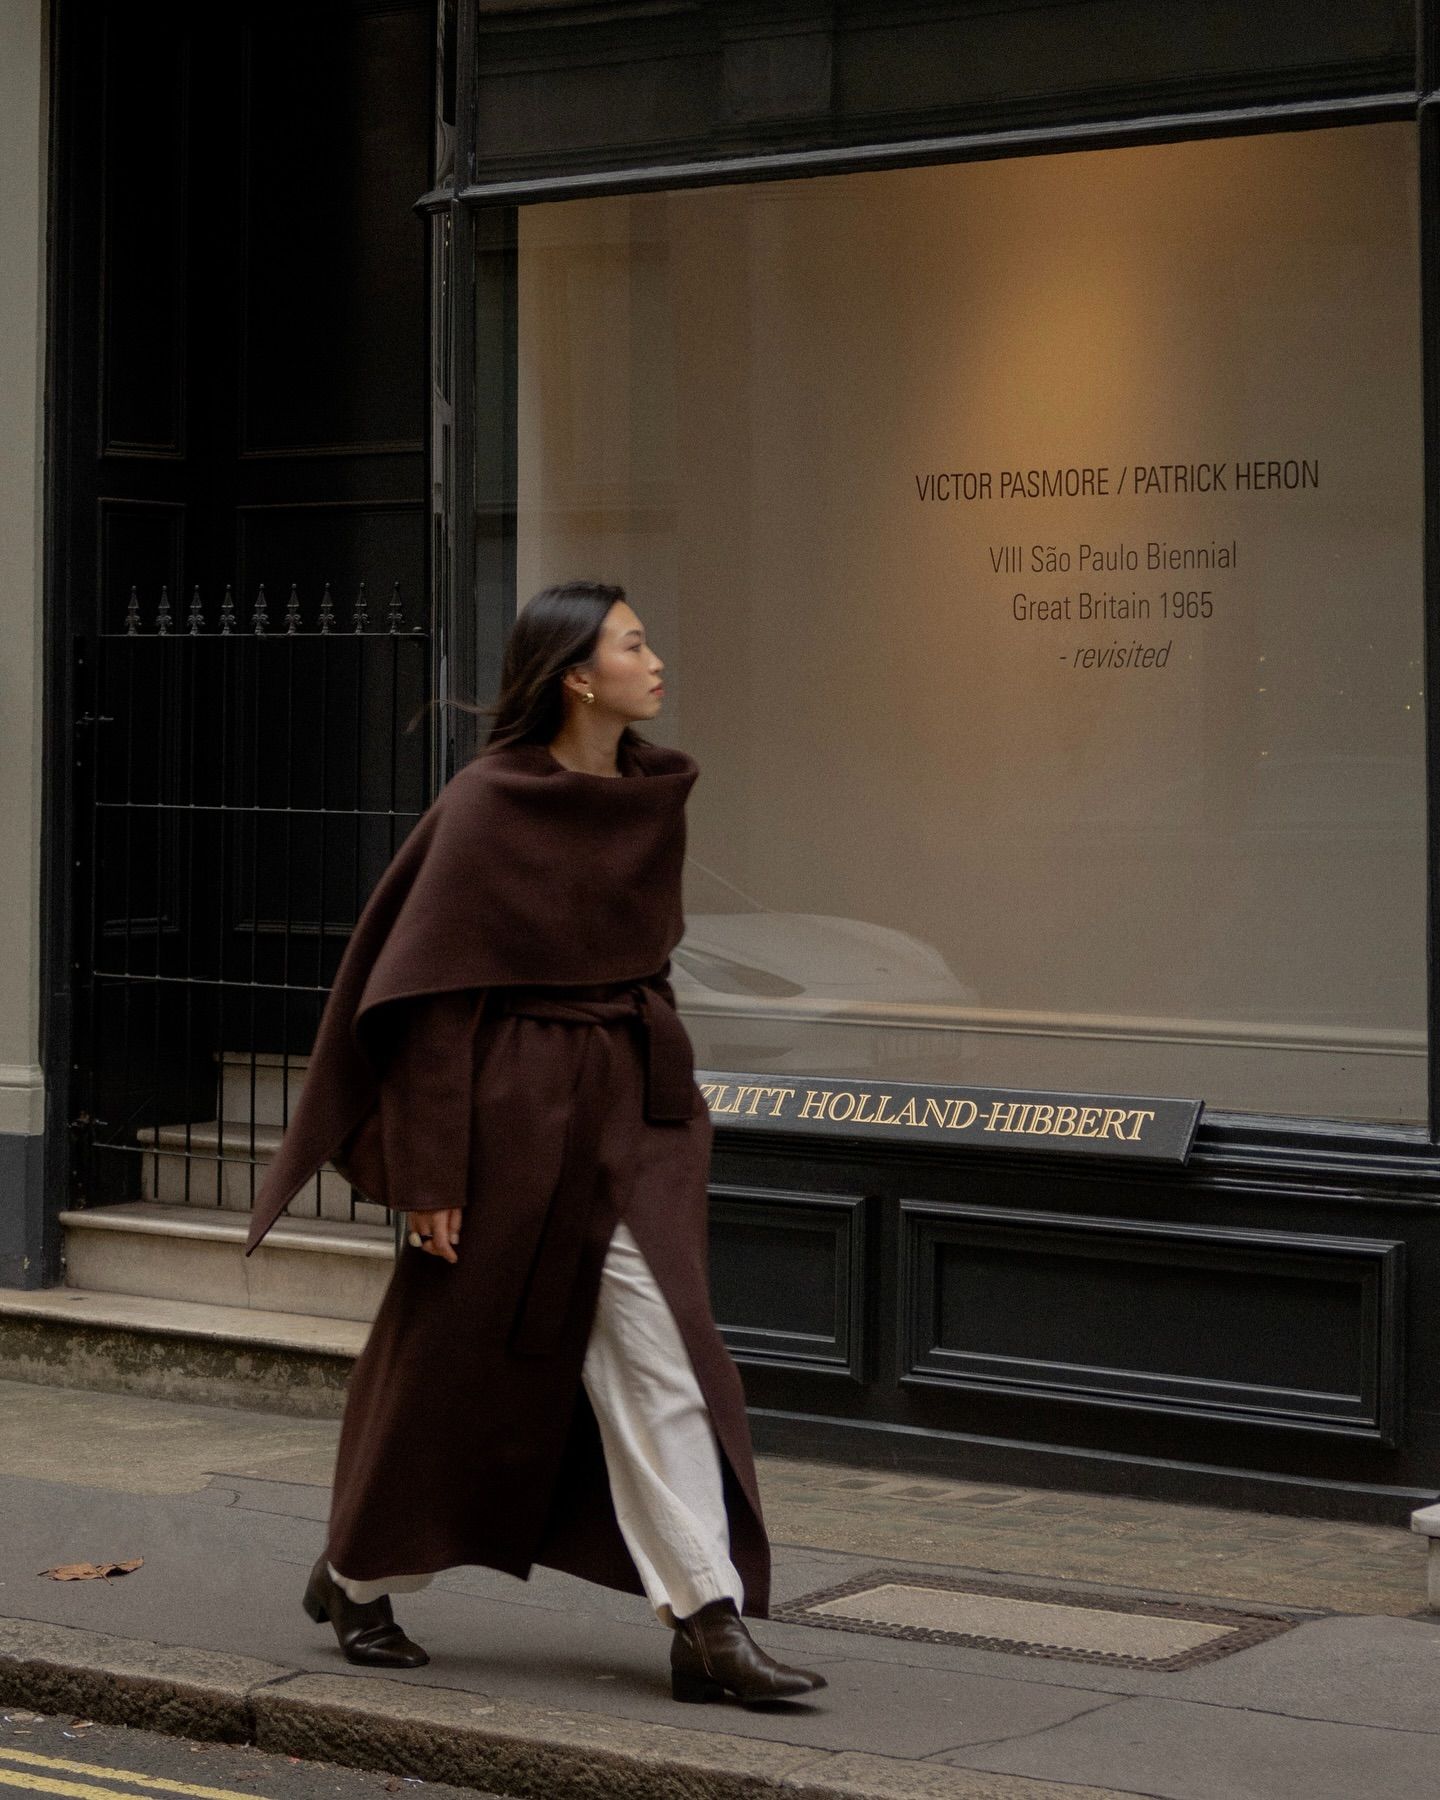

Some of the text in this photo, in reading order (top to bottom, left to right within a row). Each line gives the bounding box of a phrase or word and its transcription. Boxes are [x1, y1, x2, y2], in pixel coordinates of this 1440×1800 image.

[916, 460, 1319, 501] VICTOR PASMORE / PATRICK HERON
[989, 541, 1237, 574] VIII São Paulo Biennial
[1013, 591, 1213, 621] Great Britain 1965
[1073, 640, 1173, 669] revisited
[798, 1090, 1155, 1141] HOLLAND-HIBBERT
